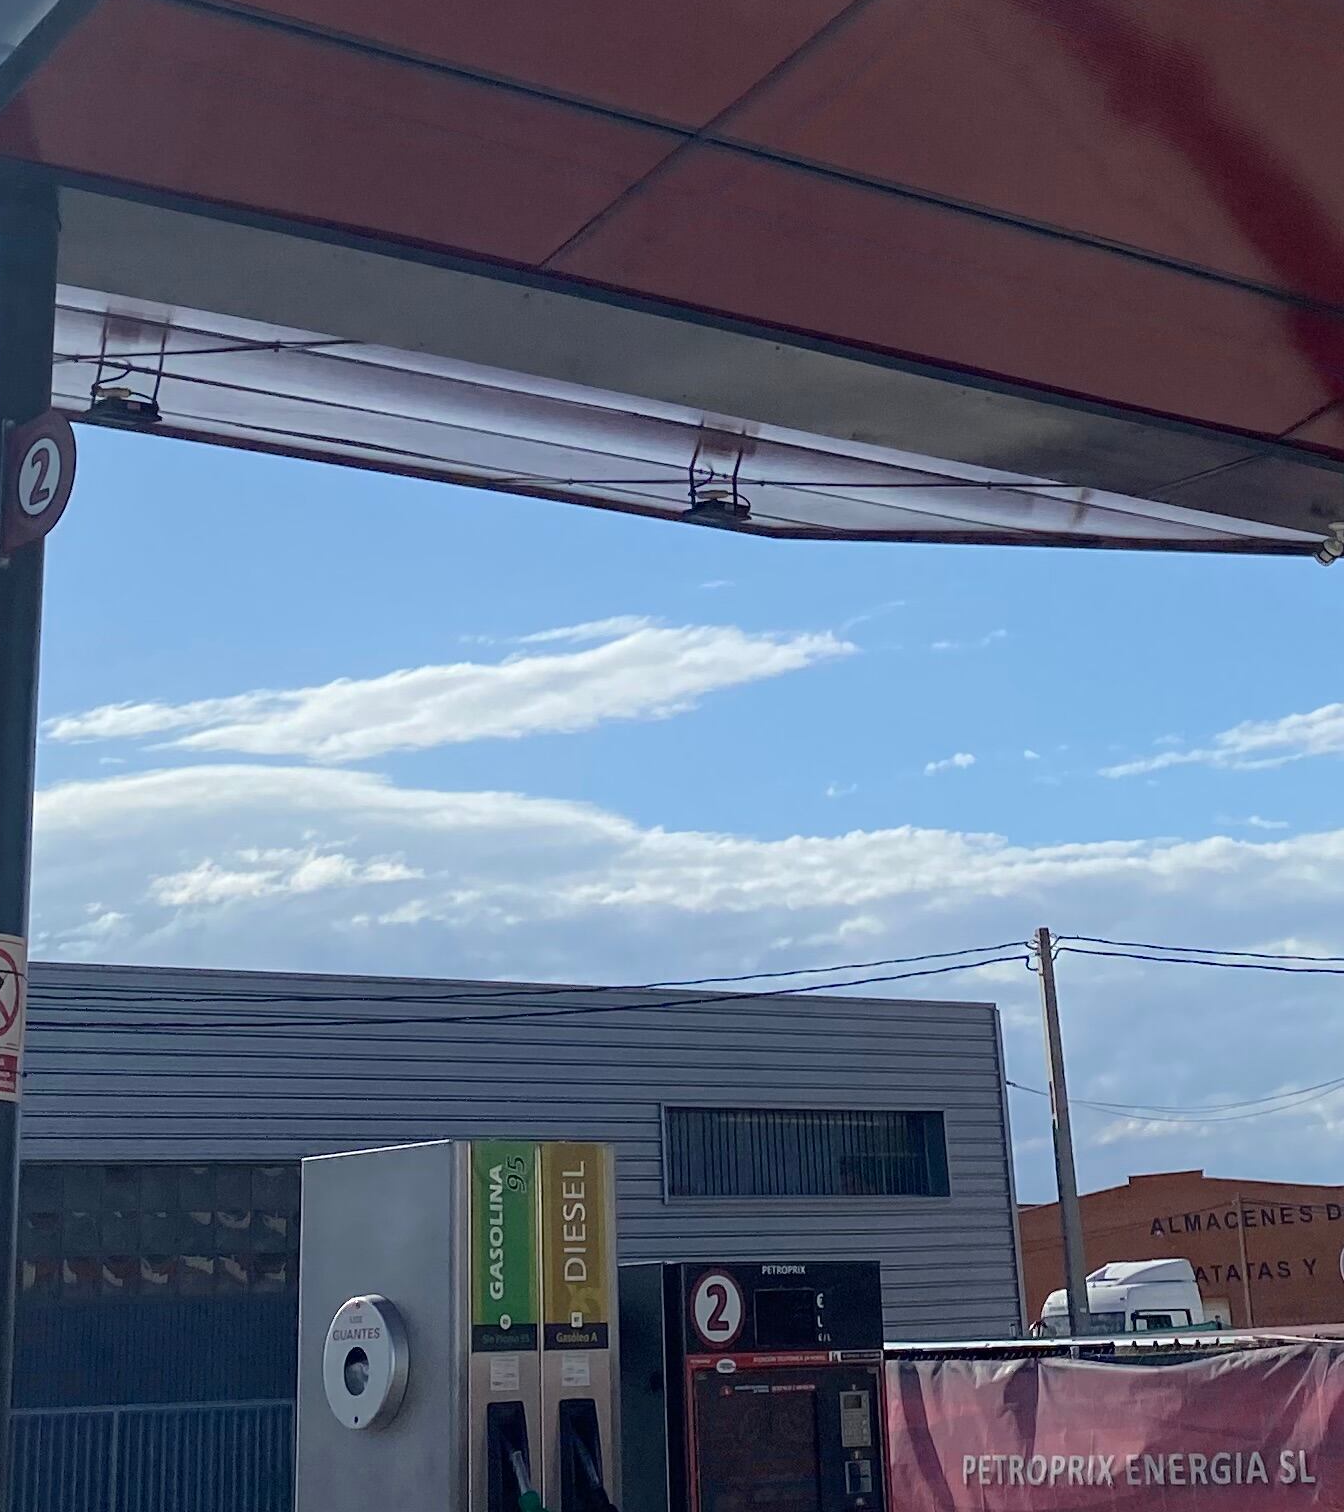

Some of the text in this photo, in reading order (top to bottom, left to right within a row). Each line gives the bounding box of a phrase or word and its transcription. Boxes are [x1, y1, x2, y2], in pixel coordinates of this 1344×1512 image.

[30, 449, 51, 506] 2
[489, 1155, 527, 1301] GASOLINA 95
[562, 1159, 587, 1284] DIESEL
[1150, 1205, 1314, 1236] ALMACENES
[762, 1265, 806, 1275] PETROPRIX
[1196, 1260, 1292, 1284] ATATAS
[1303, 1258, 1318, 1276] Y
[707, 1284, 729, 1331] 2
[332, 1327, 381, 1342] GUANTES
[590, 1332, 598, 1342] A
[962, 1449, 1316, 1487] PETROPRIX ENERGIA SL
